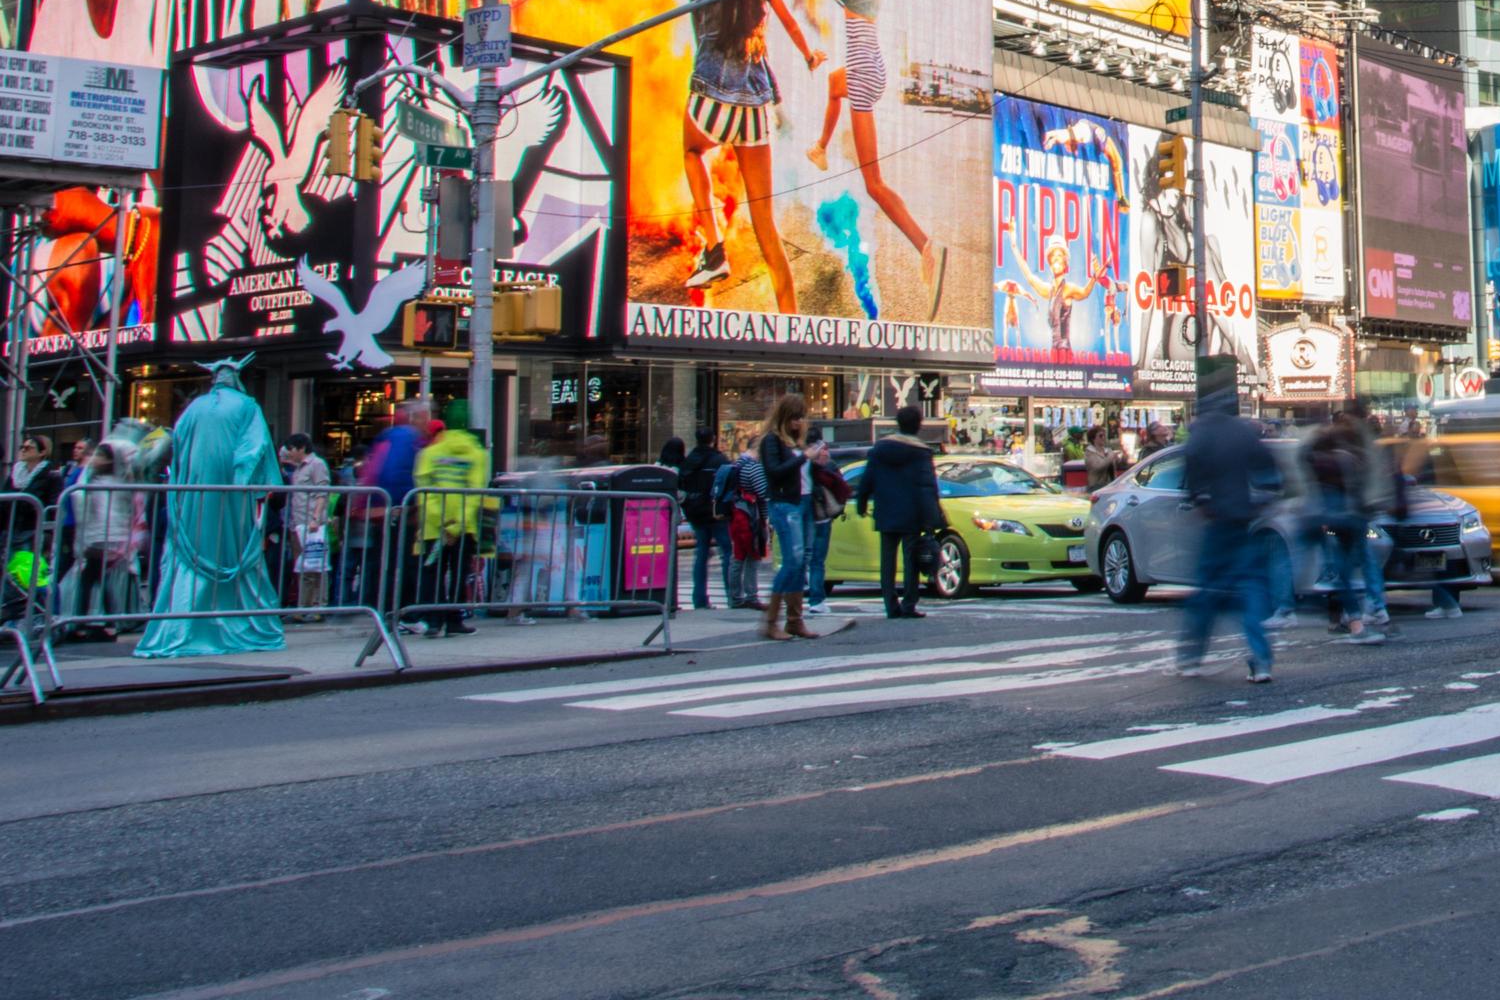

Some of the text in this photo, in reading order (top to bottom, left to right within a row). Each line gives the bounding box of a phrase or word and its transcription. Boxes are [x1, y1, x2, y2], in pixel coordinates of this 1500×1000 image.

[468, 9, 502, 26] NYPD
[464, 39, 509, 56] SECURITY
[465, 52, 506, 67] CAMERA
[1258, 55, 1280, 72] LIE
[1259, 74, 1290, 94] POWE
[69, 91, 146, 107] METROPOLITAN
[69, 99, 148, 115] ENTERPRISES INC.
[71, 119, 112, 131] BROOKLYN
[113, 123, 124, 131] NY
[97, 113, 123, 123] COURT
[67, 129, 147, 147] 718-383-3133
[406, 110, 466, 148] Broadw
[434, 147, 446, 165] 7
[1302, 152, 1325, 166] LIE
[1260, 206, 1293, 223] LIGHT
[993, 176, 1121, 281] PIPPIN
[229, 268, 296, 296] AMERICAN
[1368, 267, 1394, 300] CNN
[250, 289, 314, 312] OUTFITTERS
[1135, 271, 1253, 320] CCAGO
[632, 305, 994, 357] AMERICAN EAGLE OUTFITTERS
[1460, 375, 1483, 393] W
